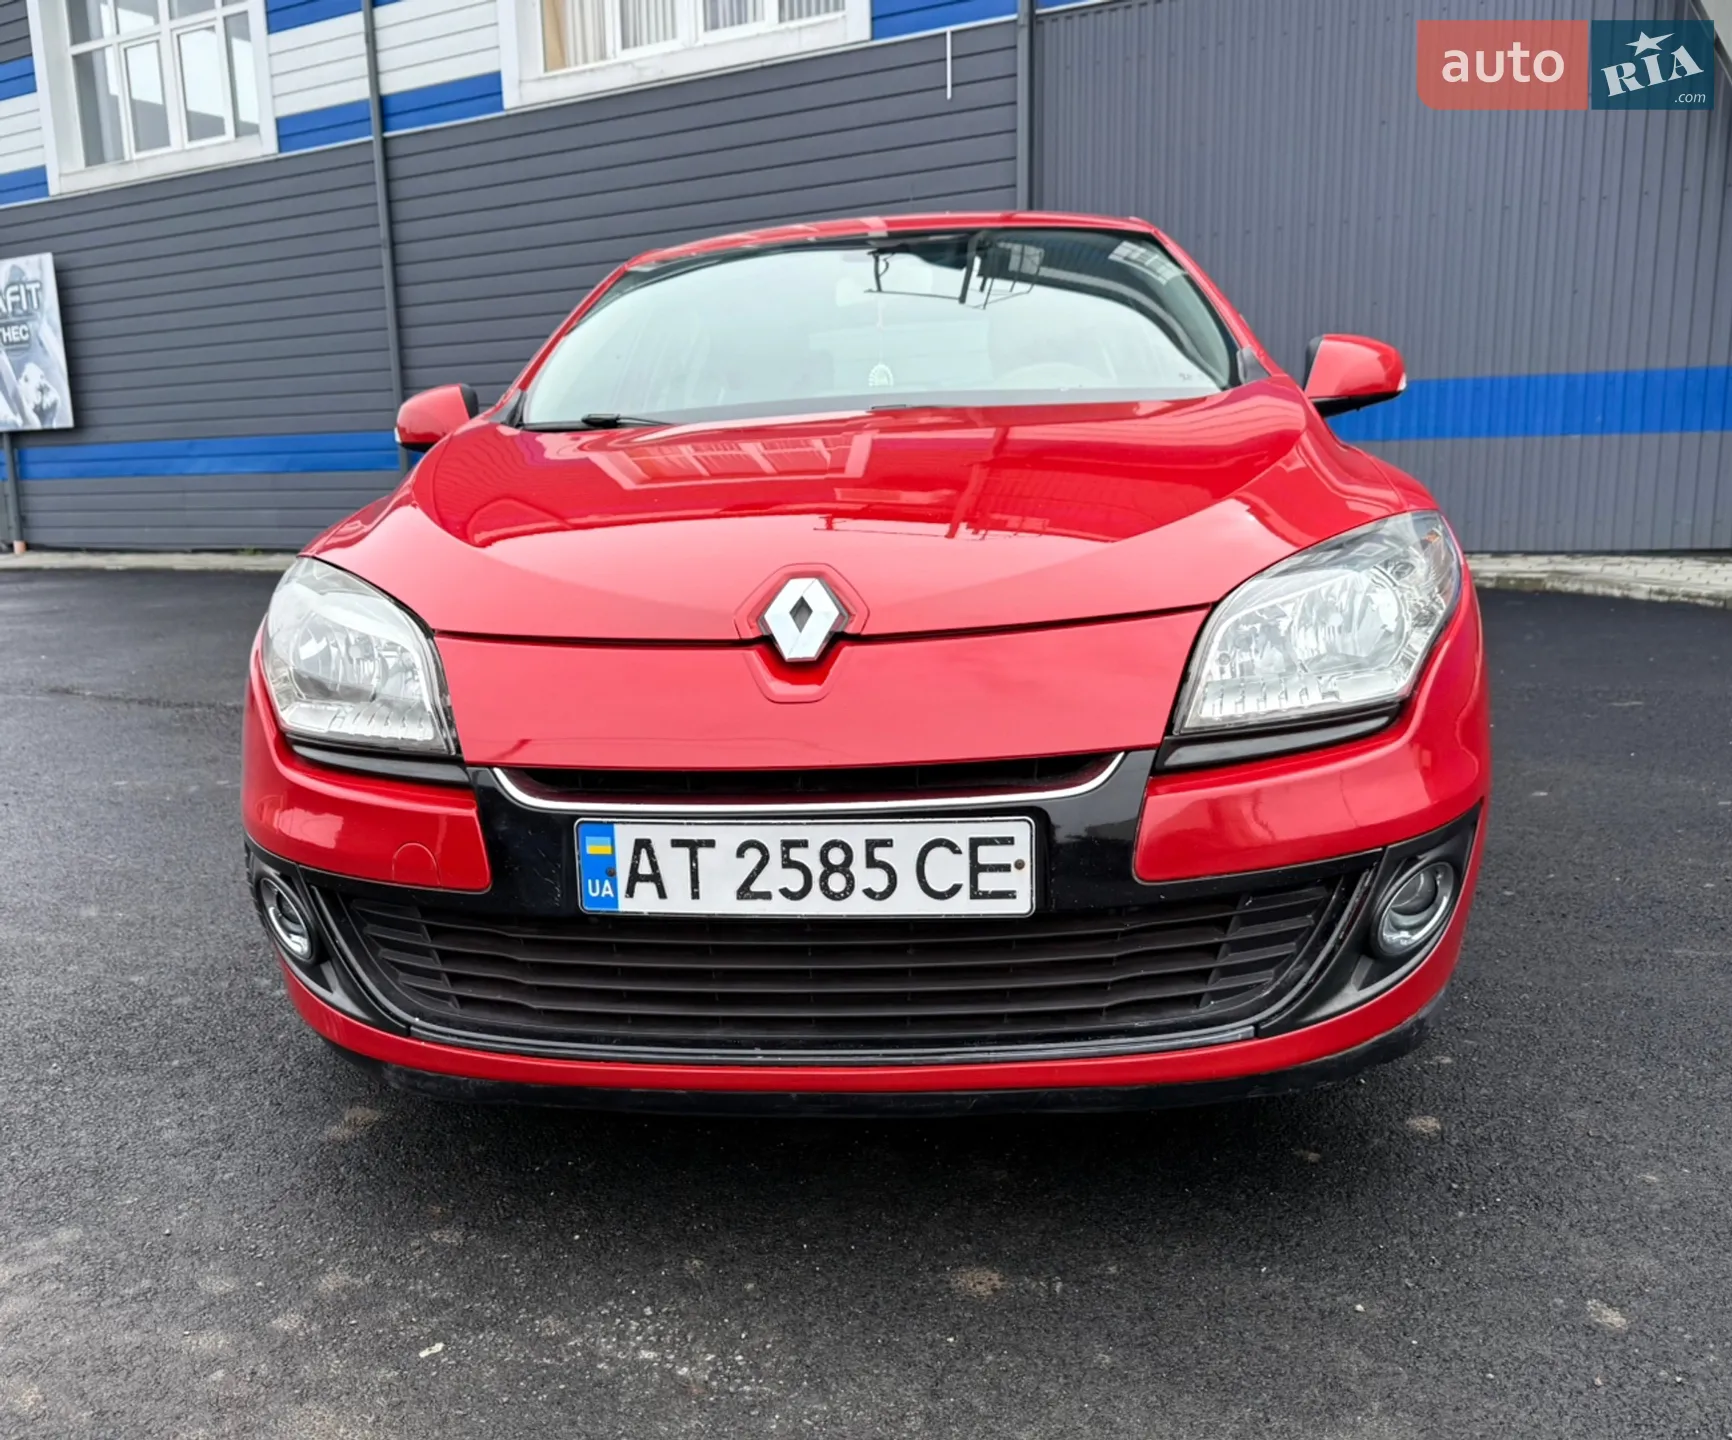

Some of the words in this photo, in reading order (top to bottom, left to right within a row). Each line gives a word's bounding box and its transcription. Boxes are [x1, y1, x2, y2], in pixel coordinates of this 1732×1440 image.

[587, 879, 614, 898] UA
[623, 838, 716, 900] AT
[734, 837, 899, 901] 2585
[915, 835, 1018, 901] CE
